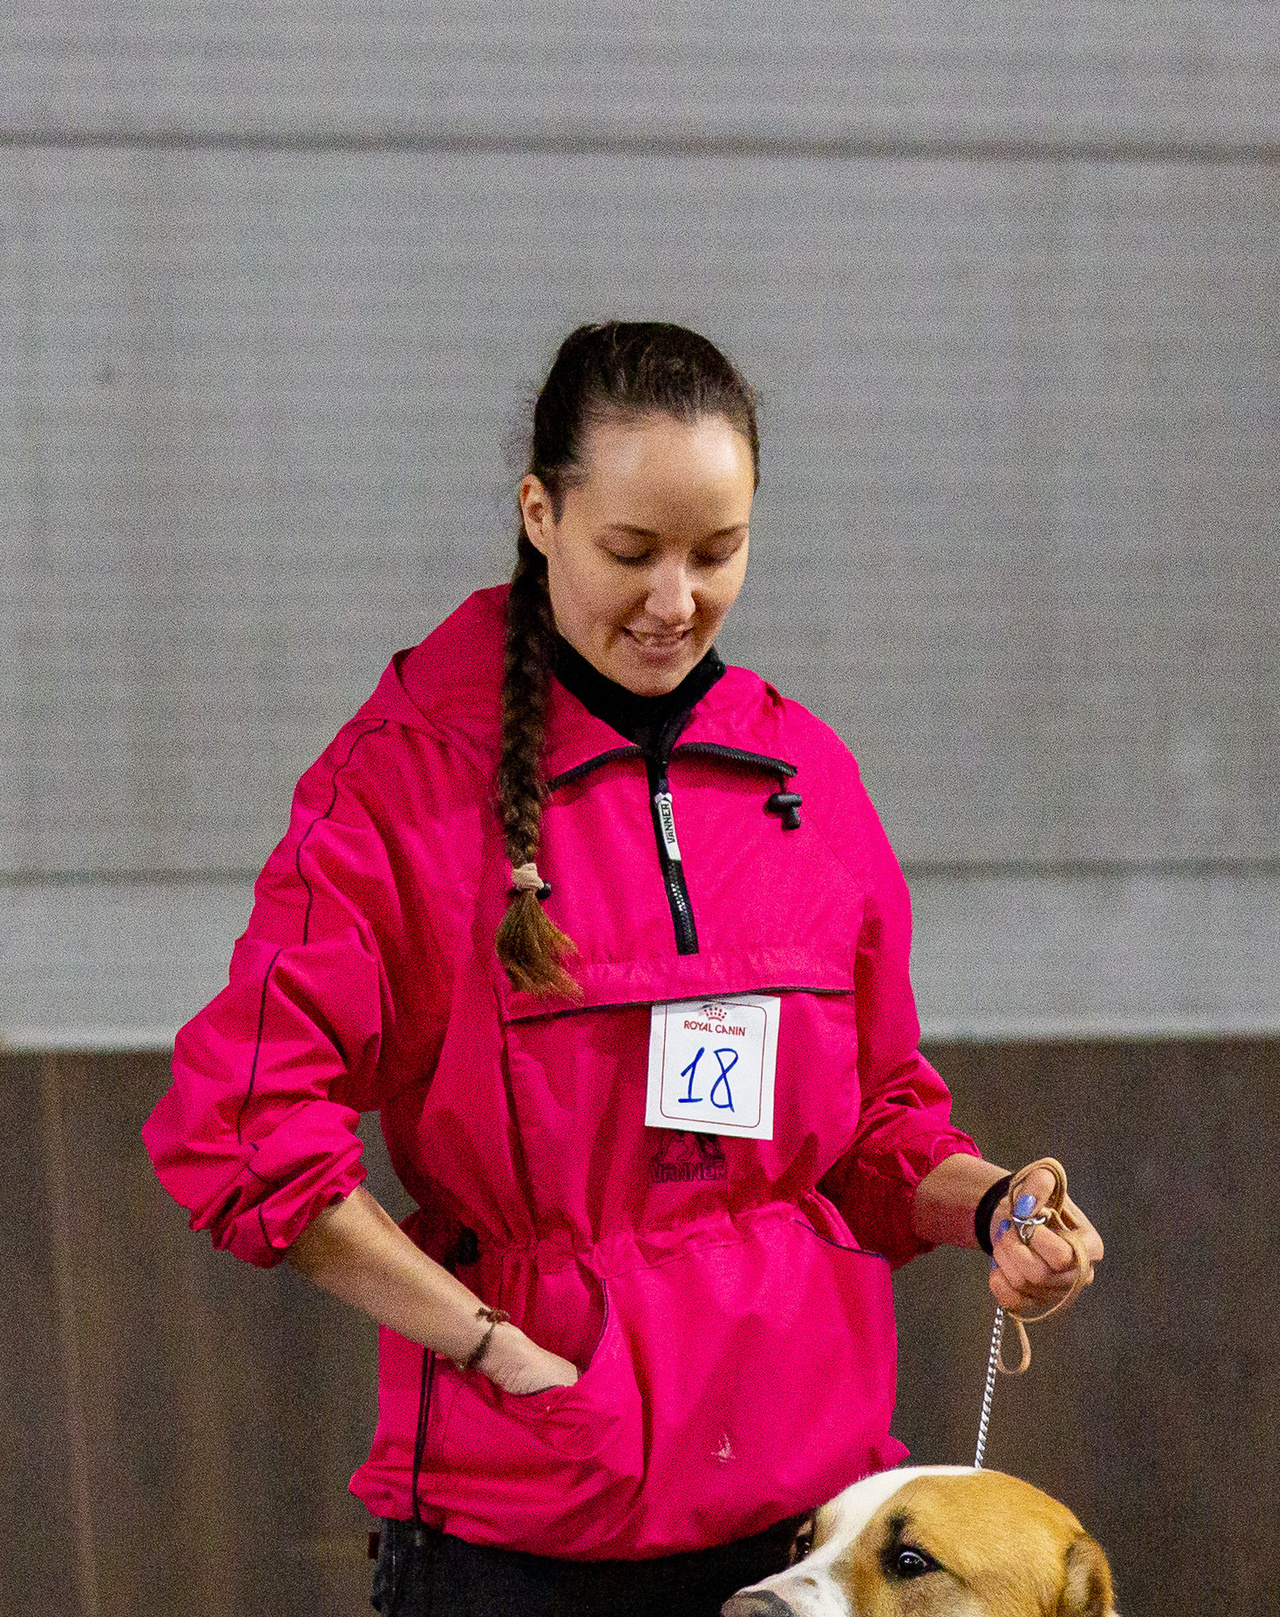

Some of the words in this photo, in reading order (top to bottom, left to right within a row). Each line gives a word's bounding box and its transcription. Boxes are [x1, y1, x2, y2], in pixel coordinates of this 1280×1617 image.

[684, 1020, 713, 1033] ROYAL
[715, 1024, 746, 1037] CANIN
[678, 1047, 739, 1113] 18
